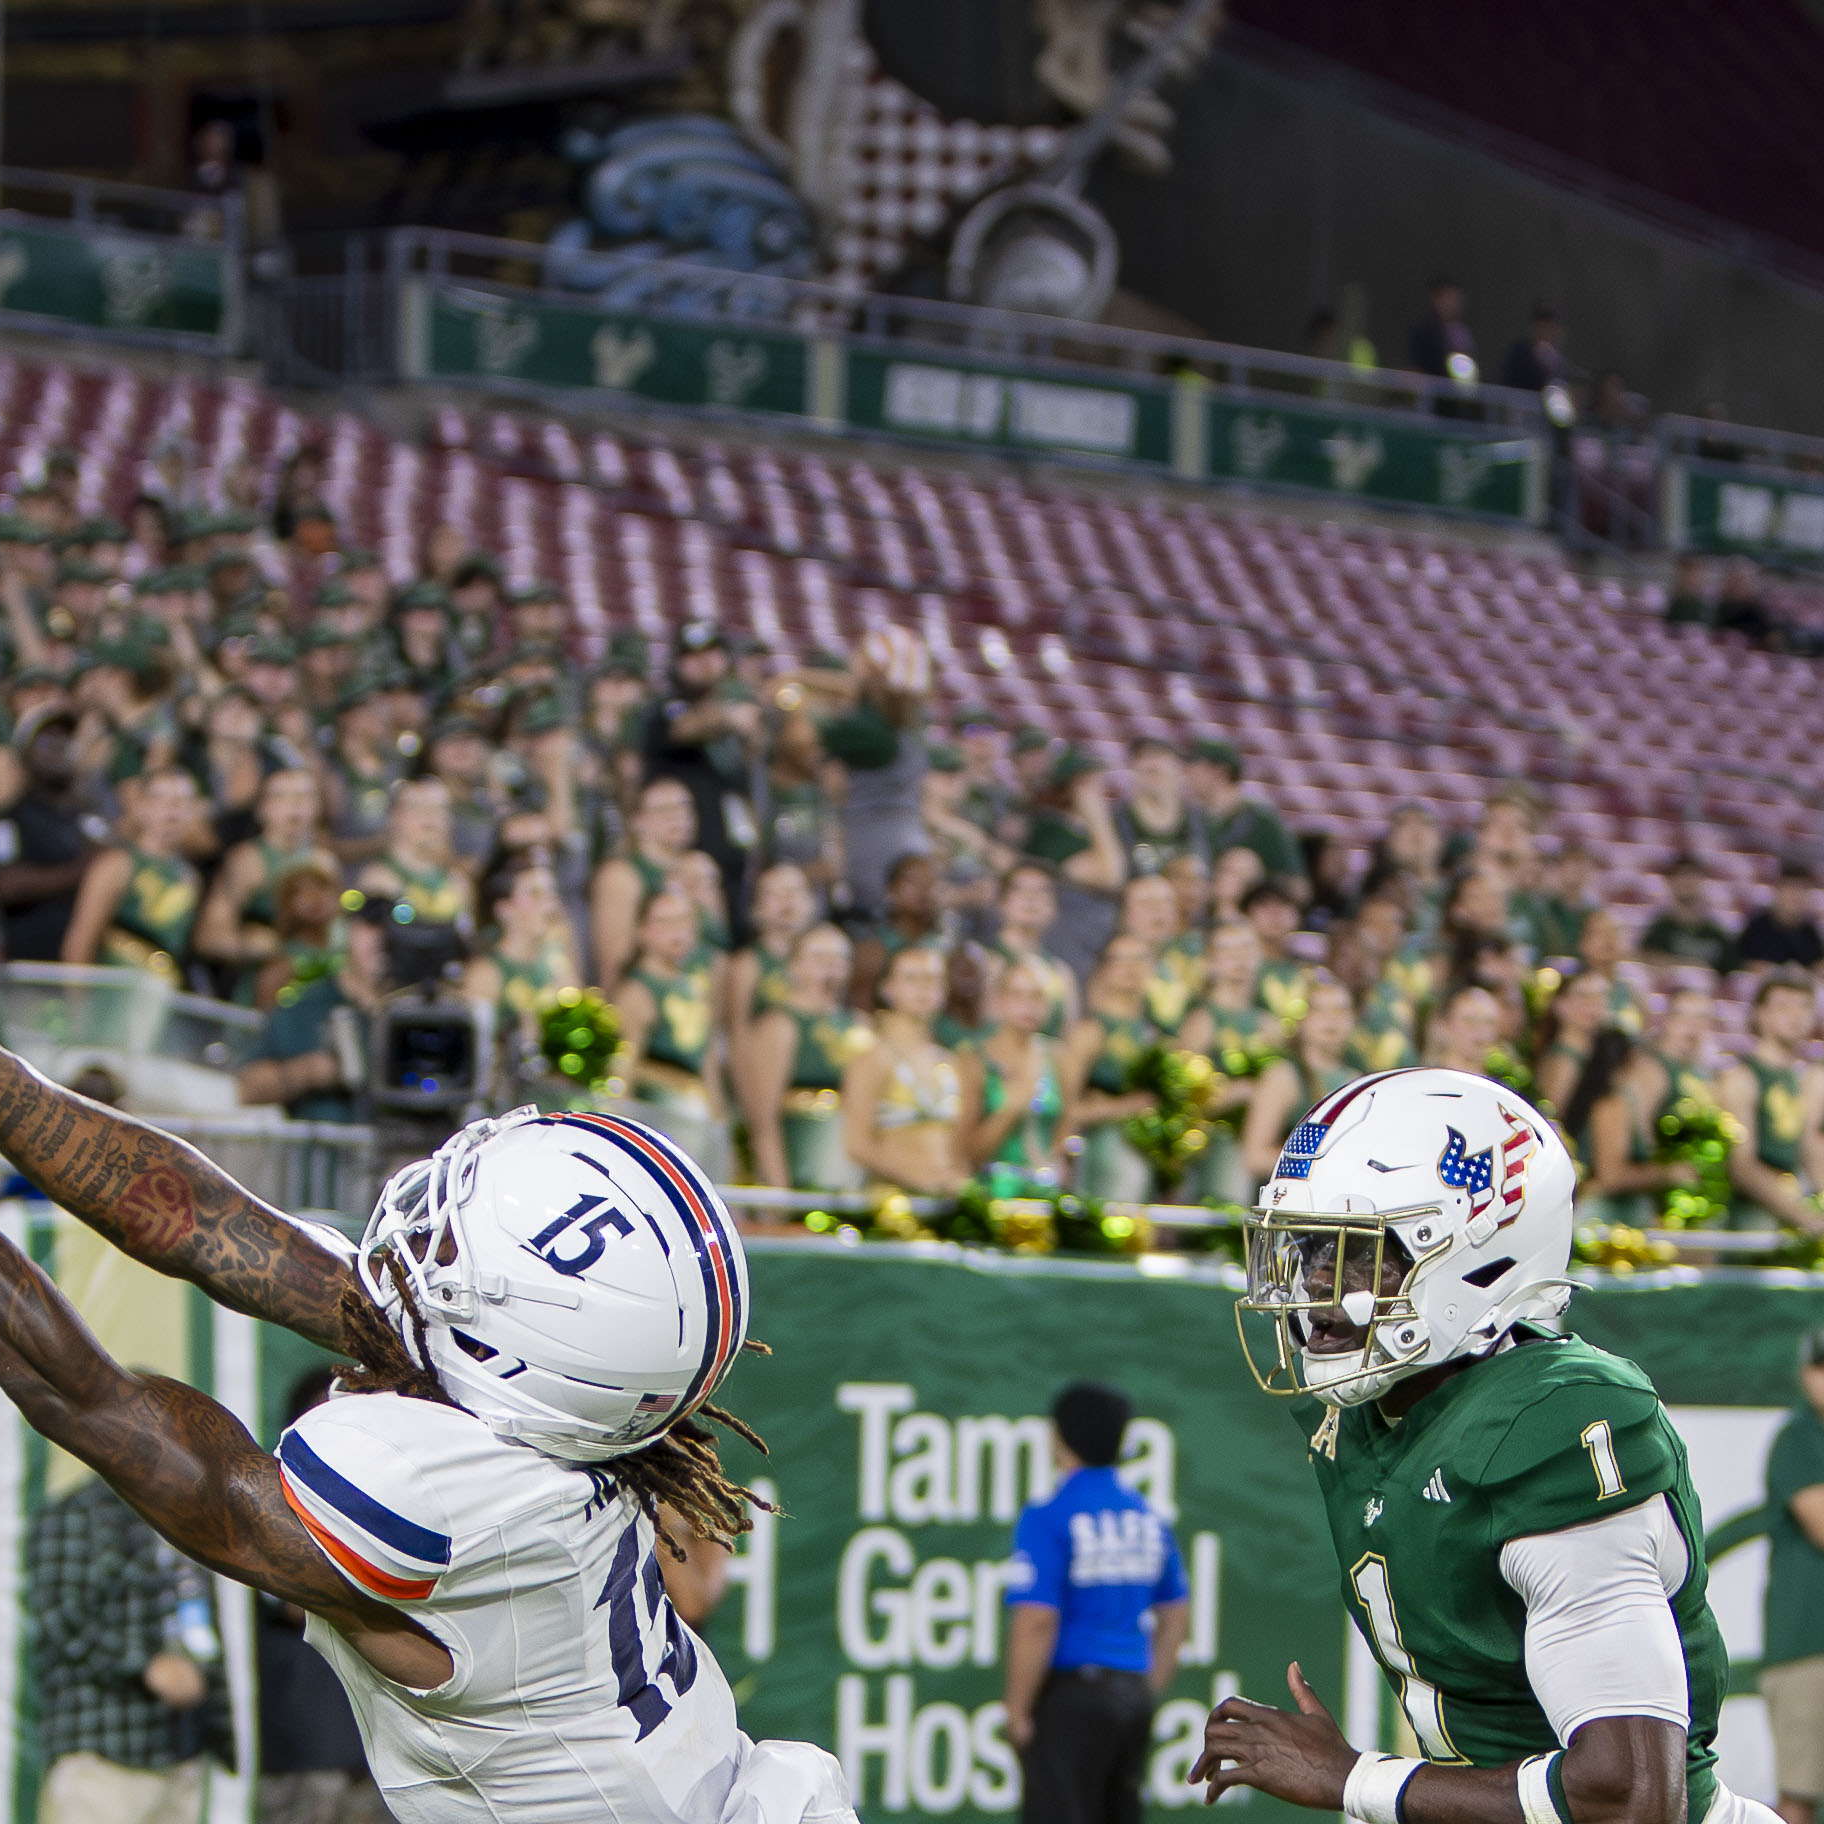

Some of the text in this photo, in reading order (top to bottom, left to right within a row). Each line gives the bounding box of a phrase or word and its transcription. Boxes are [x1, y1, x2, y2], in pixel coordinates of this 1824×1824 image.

[527, 1193, 636, 1276] 15
[835, 1382, 1179, 1524] Tama
[1580, 1420, 1628, 1501] 1
[1350, 1550, 1475, 1767] 1
